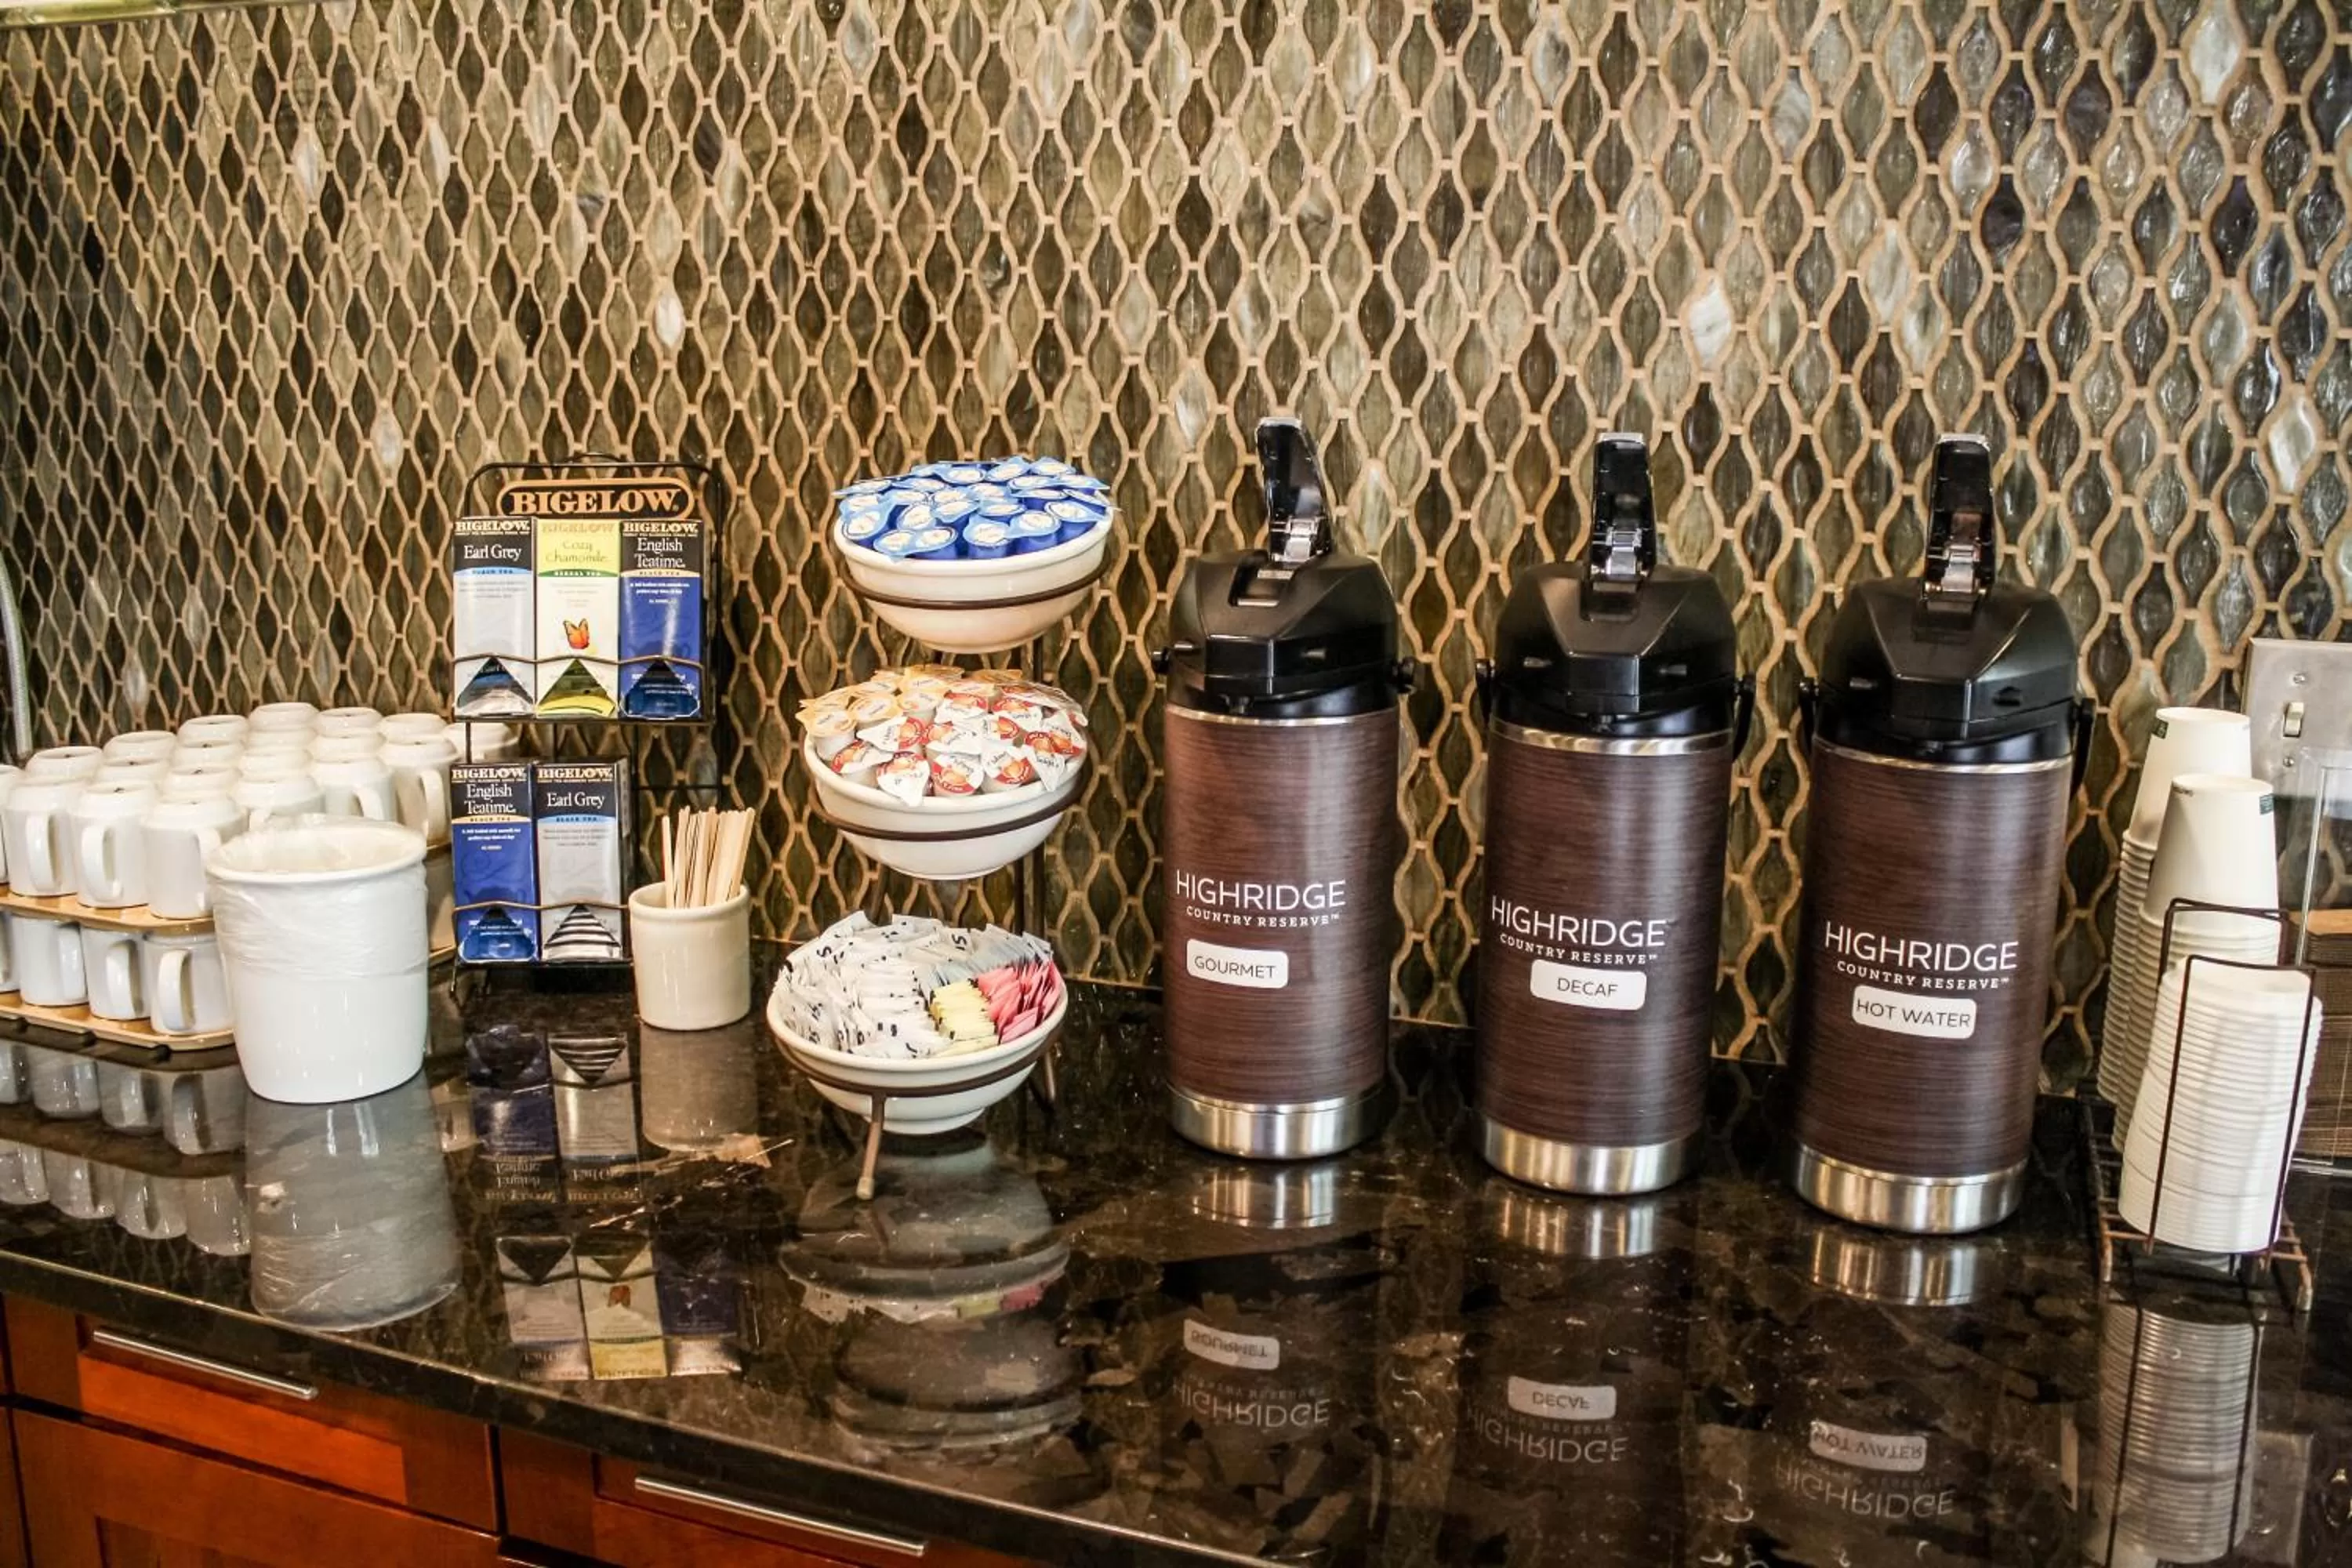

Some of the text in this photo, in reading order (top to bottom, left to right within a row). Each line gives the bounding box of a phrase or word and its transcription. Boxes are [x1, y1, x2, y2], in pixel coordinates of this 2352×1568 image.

[463, 543, 523, 561] Earl Grey
[637, 537, 683, 554] English
[466, 783, 513, 800] English
[546, 791, 605, 809] Earl Grey
[1176, 869, 1347, 911] HIGHRIDGE
[1186, 906, 1253, 927] COUNTRY
[1491, 895, 1667, 948] HIGHRIDGE
[1499, 934, 1566, 960] COUNTRY
[1824, 920, 2019, 972] HIGHRIDGE
[1194, 955, 1276, 979] GOURMET
[1837, 960, 1916, 986] COUNTRY
[1556, 977, 1619, 997] DECAF
[1856, 998, 1972, 1028] HOT WATER
